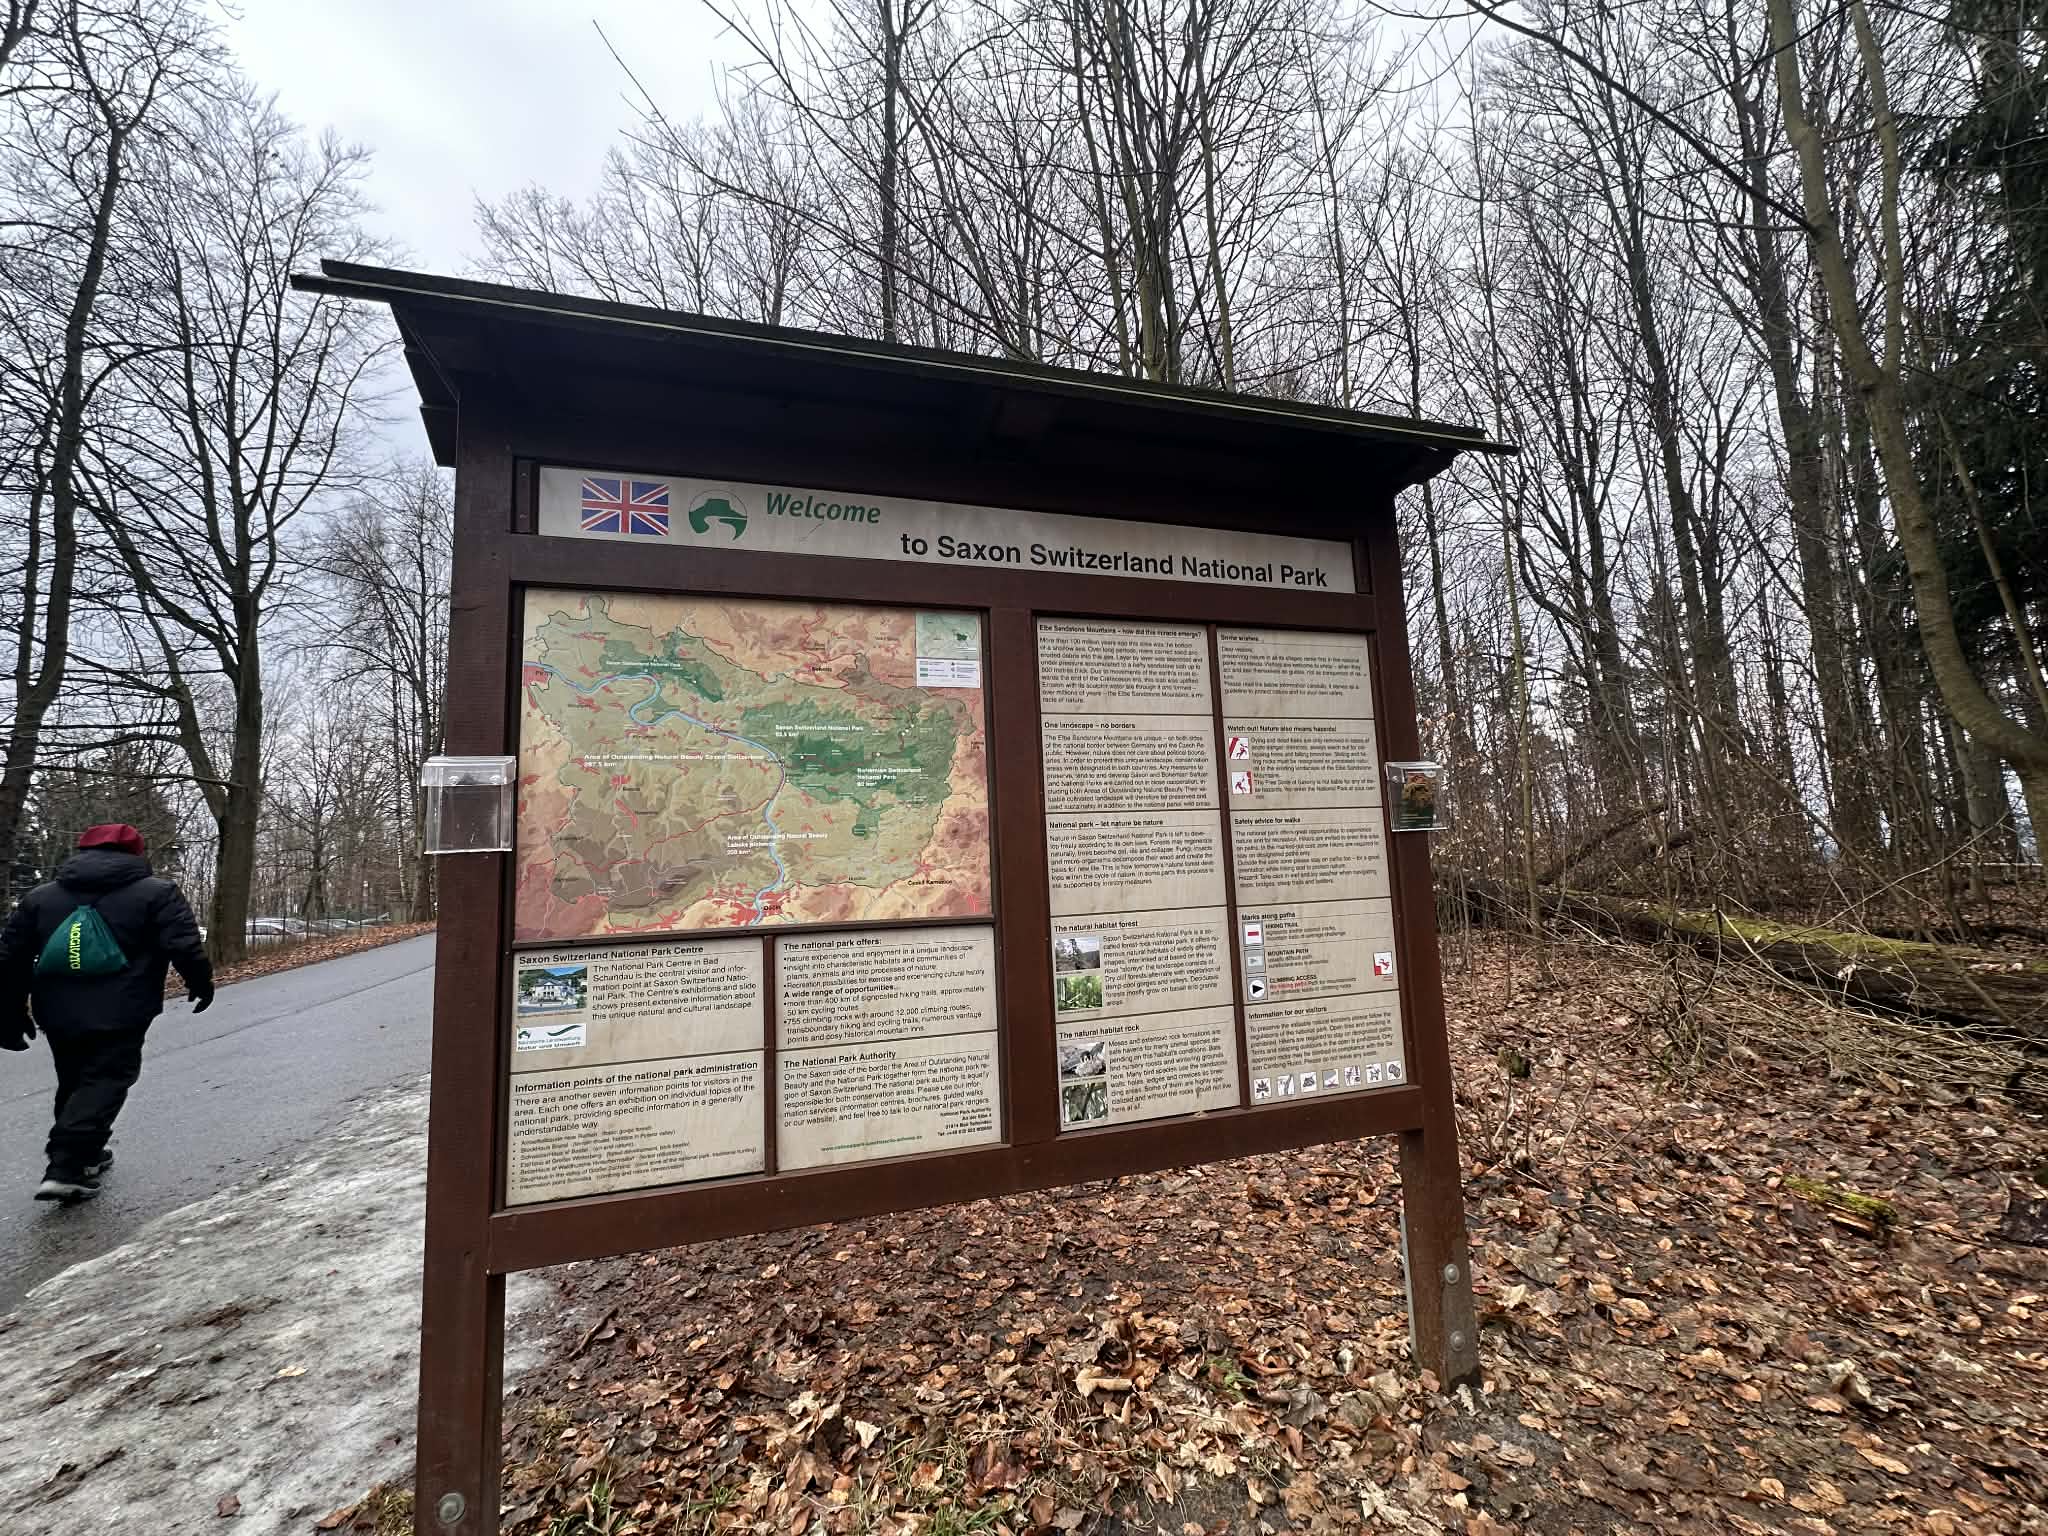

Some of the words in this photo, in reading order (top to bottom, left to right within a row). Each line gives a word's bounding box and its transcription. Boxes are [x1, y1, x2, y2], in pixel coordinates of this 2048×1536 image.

[766, 492, 881, 524] Welcome
[900, 533, 929, 556] to
[937, 535, 1021, 563] Saxon
[1030, 543, 1174, 575] Switzerland
[1181, 556, 1273, 583] National
[1280, 565, 1328, 588] Park
[784, 942, 799, 951] The
[801, 940, 835, 950] national
[836, 939, 855, 950] park
[520, 956, 550, 964] Saxon
[552, 951, 608, 962] Switzerland
[610, 949, 649, 959] National
[651, 948, 672, 956] Park
[673, 946, 704, 955] Centre
[594, 964, 609, 972] The
[610, 962, 644, 971] National
[645, 961, 664, 969] Park
[665, 960, 692, 968] Centre
[702, 957, 719, 966] Bad
[593, 973, 634, 982] Schandau
[644, 971, 657, 979] the
[658, 969, 685, 978] central
[686, 968, 710, 976] visitor
[711, 966, 726, 974] and
[727, 966, 747, 974] infor-
[593, 982, 620, 991] mation
[621, 981, 642, 991] point
[643, 980, 652, 988] at
[679, 975, 725, 985] Switzerland
[725, 974, 748, 982] Natio-
[592, 992, 605, 1000] nal
[629, 990, 645, 998] The
[646, 988, 680, 997] Centre's
[680, 985, 722, 994] exhibitions
[722, 983, 738, 992] and
[738, 982, 756, 990] slide
[791, 990, 810, 998] wide
[811, 989, 834, 997] range
[834, 987, 843, 995] of
[592, 1002, 619, 1010] shows
[620, 999, 651, 1010] present
[651, 997, 689, 1006] extensive
[690, 994, 733, 1003] information
[734, 992, 756, 1000] about
[592, 1012, 607, 1020] this
[608, 1011, 636, 1020] unique
[637, 1007, 665, 1016] natural
[666, 1006, 682, 1014] and
[682, 1004, 712, 1013] cultural
[810, 1006, 836, 1016] cycling
[784, 1060, 800, 1068] The
[801, 1056, 837, 1067] National
[838, 1054, 857, 1064] Park
[858, 1051, 896, 1062] Authority
[515, 1080, 571, 1093] Information
[573, 1077, 603, 1089] points
[605, 1075, 615, 1084] of
[617, 1074, 632, 1083] the
[634, 1069, 671, 1081] national
[673, 1067, 694, 1079] park
[695, 1062, 758, 1075] administration
[515, 1098, 540, 1106] There
[541, 1096, 556, 1104] are
[558, 1092, 590, 1102] another
[592, 1090, 617, 1098] seven
[618, 1084, 664, 1096] information
[664, 1081, 690, 1093] points
[690, 1080, 702, 1088] for
[702, 1078, 731, 1087] visitors
[731, 1076, 739, 1084] in
[740, 1075, 753, 1083] the
[538, 1104, 560, 1114] Each
[580, 1101, 604, 1109] offers
[618, 1095, 657, 1105] exhibition
[670, 1088, 708, 1100] individual
[709, 1087, 732, 1097] topics
[733, 1085, 741, 1093] of
[742, 1084, 755, 1092] the
[514, 1116, 548, 1127] national
[573, 1110, 612, 1122] providing
[613, 1106, 645, 1118] specific
[645, 1102, 690, 1113] information
[691, 1100, 700, 1108] in
[707, 1096, 744, 1108] generally
[513, 1123, 580, 1137] understandable
